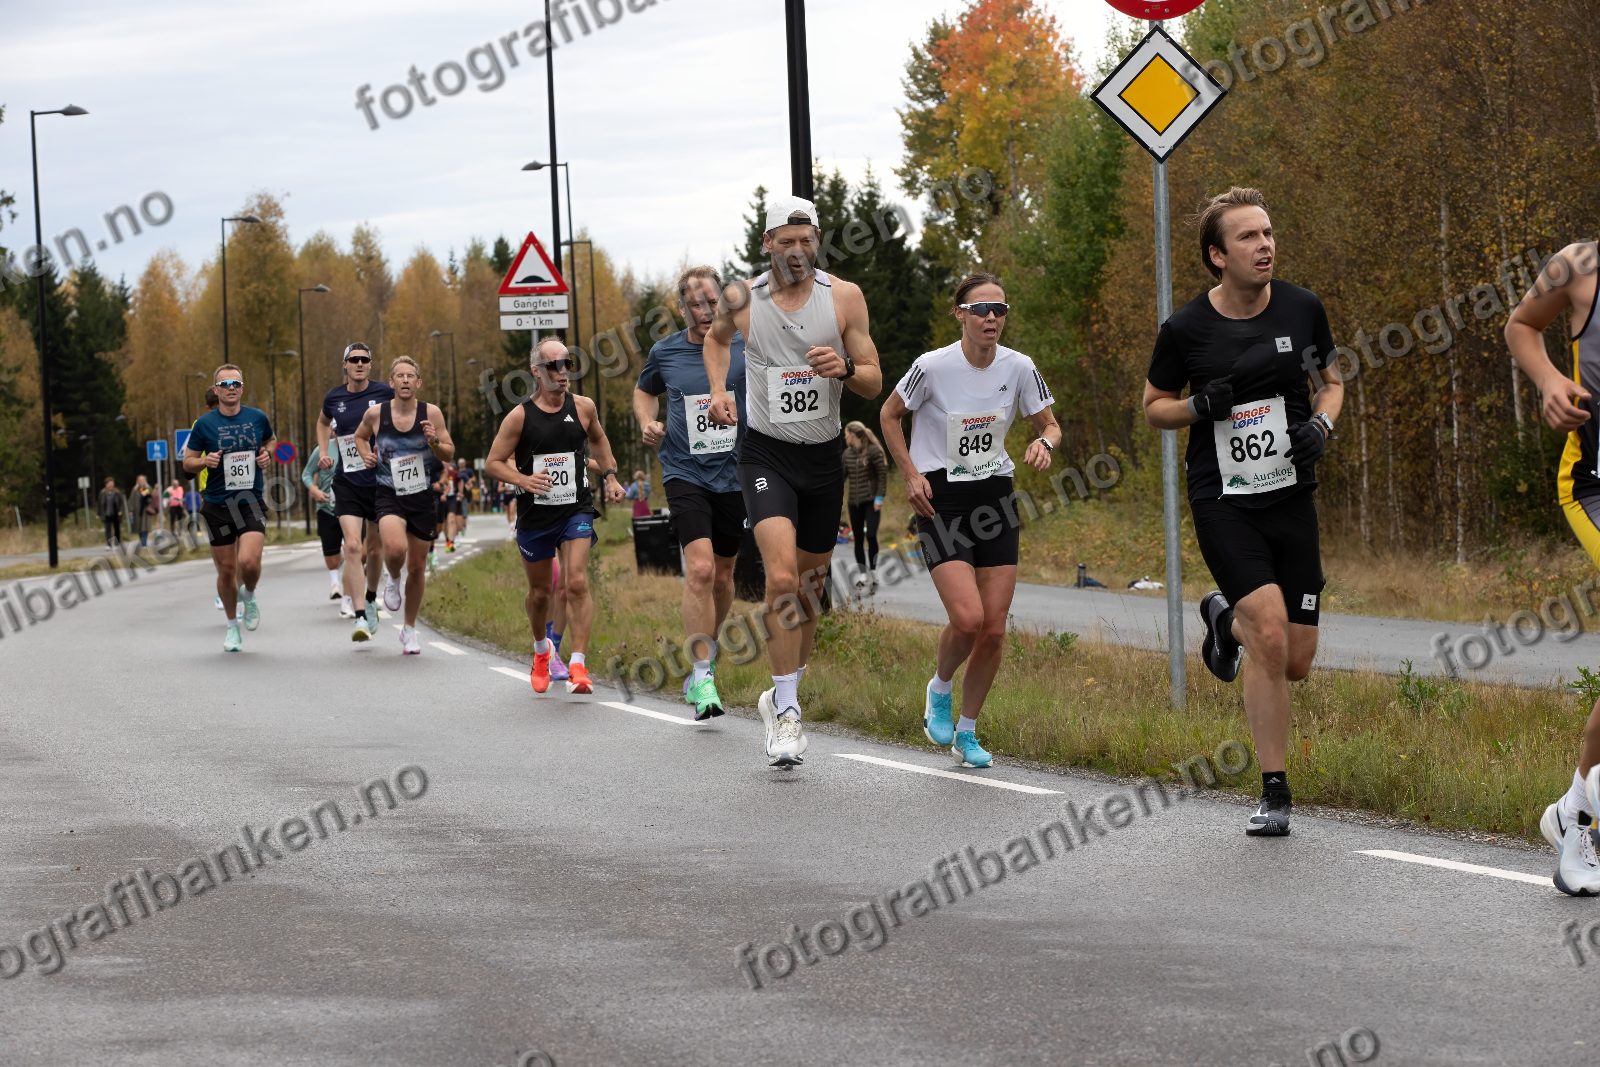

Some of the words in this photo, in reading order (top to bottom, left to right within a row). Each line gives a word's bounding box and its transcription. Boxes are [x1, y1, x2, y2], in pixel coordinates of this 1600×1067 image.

[513, 299, 555, 309] Gangfelt
[539, 317, 553, 326] km
[784, 377, 813, 386] LØPET
[780, 390, 819, 413] 382
[696, 415, 728, 432] 84
[961, 415, 997, 425] NORGES
[964, 423, 990, 431] LØPET
[1232, 415, 1266, 429] LØPET
[958, 433, 993, 456] 849
[1230, 430, 1278, 463] 862
[346, 446, 359, 458] 42
[230, 464, 250, 476] 361
[398, 467, 419, 482] 774
[1253, 466, 1294, 482] Aurskog
[549, 470, 568, 486] 20
